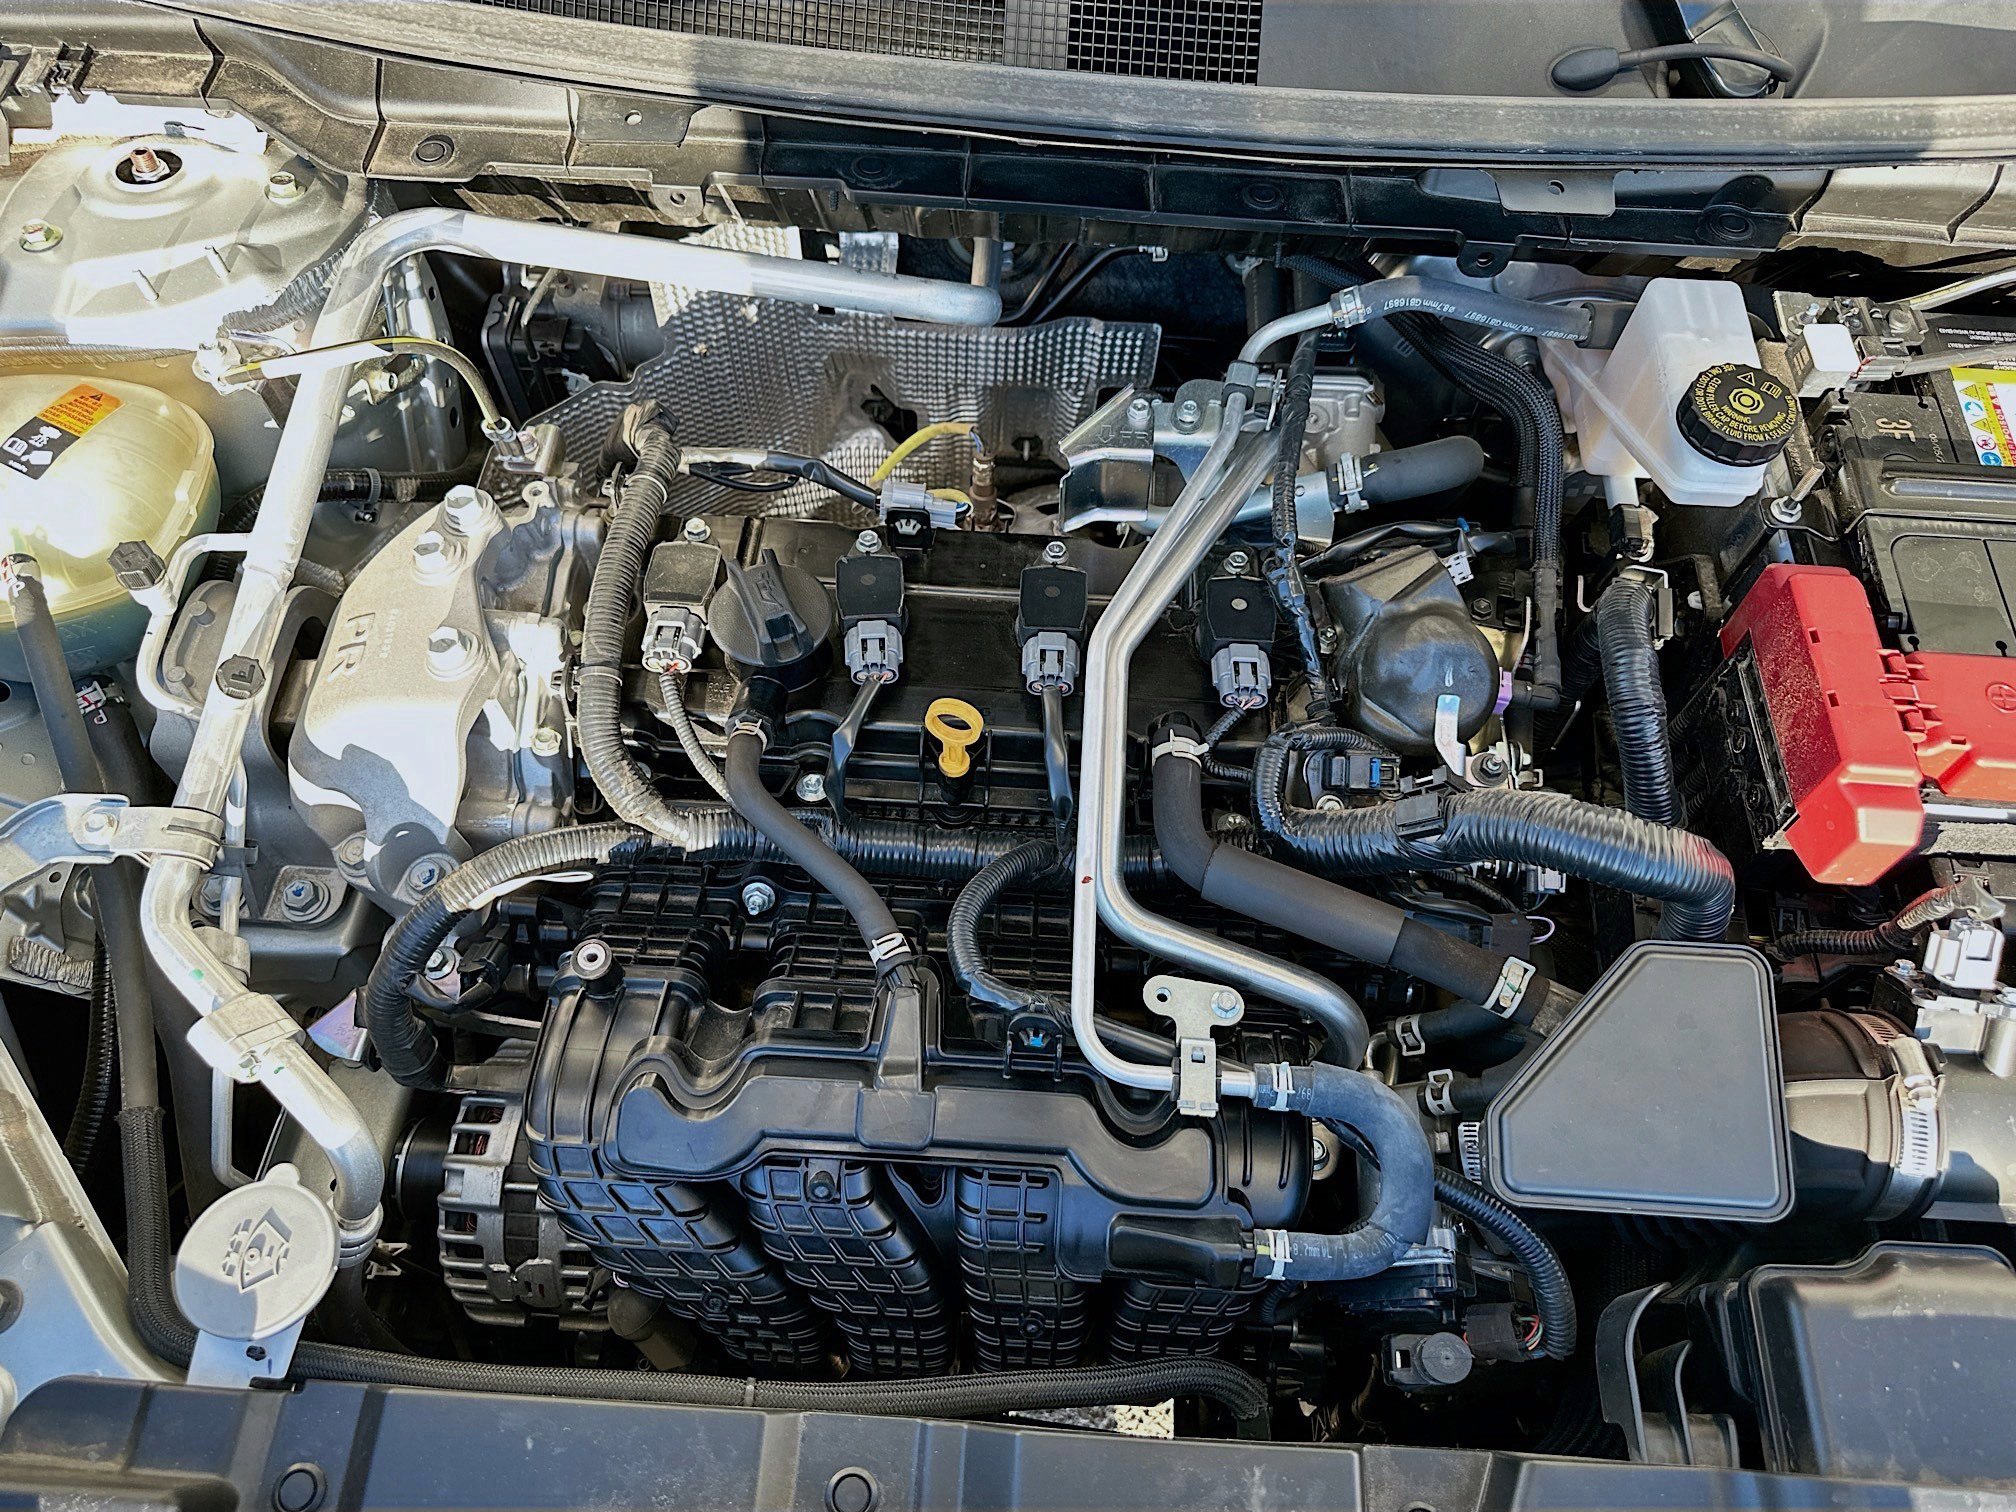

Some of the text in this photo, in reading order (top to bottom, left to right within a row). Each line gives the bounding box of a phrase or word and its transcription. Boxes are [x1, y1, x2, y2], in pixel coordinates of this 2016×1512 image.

[1383, 297, 1422, 311] GB16897
[1464, 310, 1501, 326] GB16897
[1706, 366, 1723, 378] ONLY
[1720, 364, 1736, 373] USE
[1694, 387, 1704, 397] OR
[1705, 376, 1787, 434] CLEAN FILLER CAP BEFORE REMOVING
[1784, 394, 1797, 426] CONTAINER
[1702, 410, 1723, 430] BRAKE
[1720, 404, 1753, 425] WARNING
[1721, 425, 1743, 439] FLUID
[1743, 432, 1765, 442] FROM
[1764, 431, 1771, 441] A
[1770, 423, 1791, 440] SEALED
[1875, 418, 1917, 443] 3F
